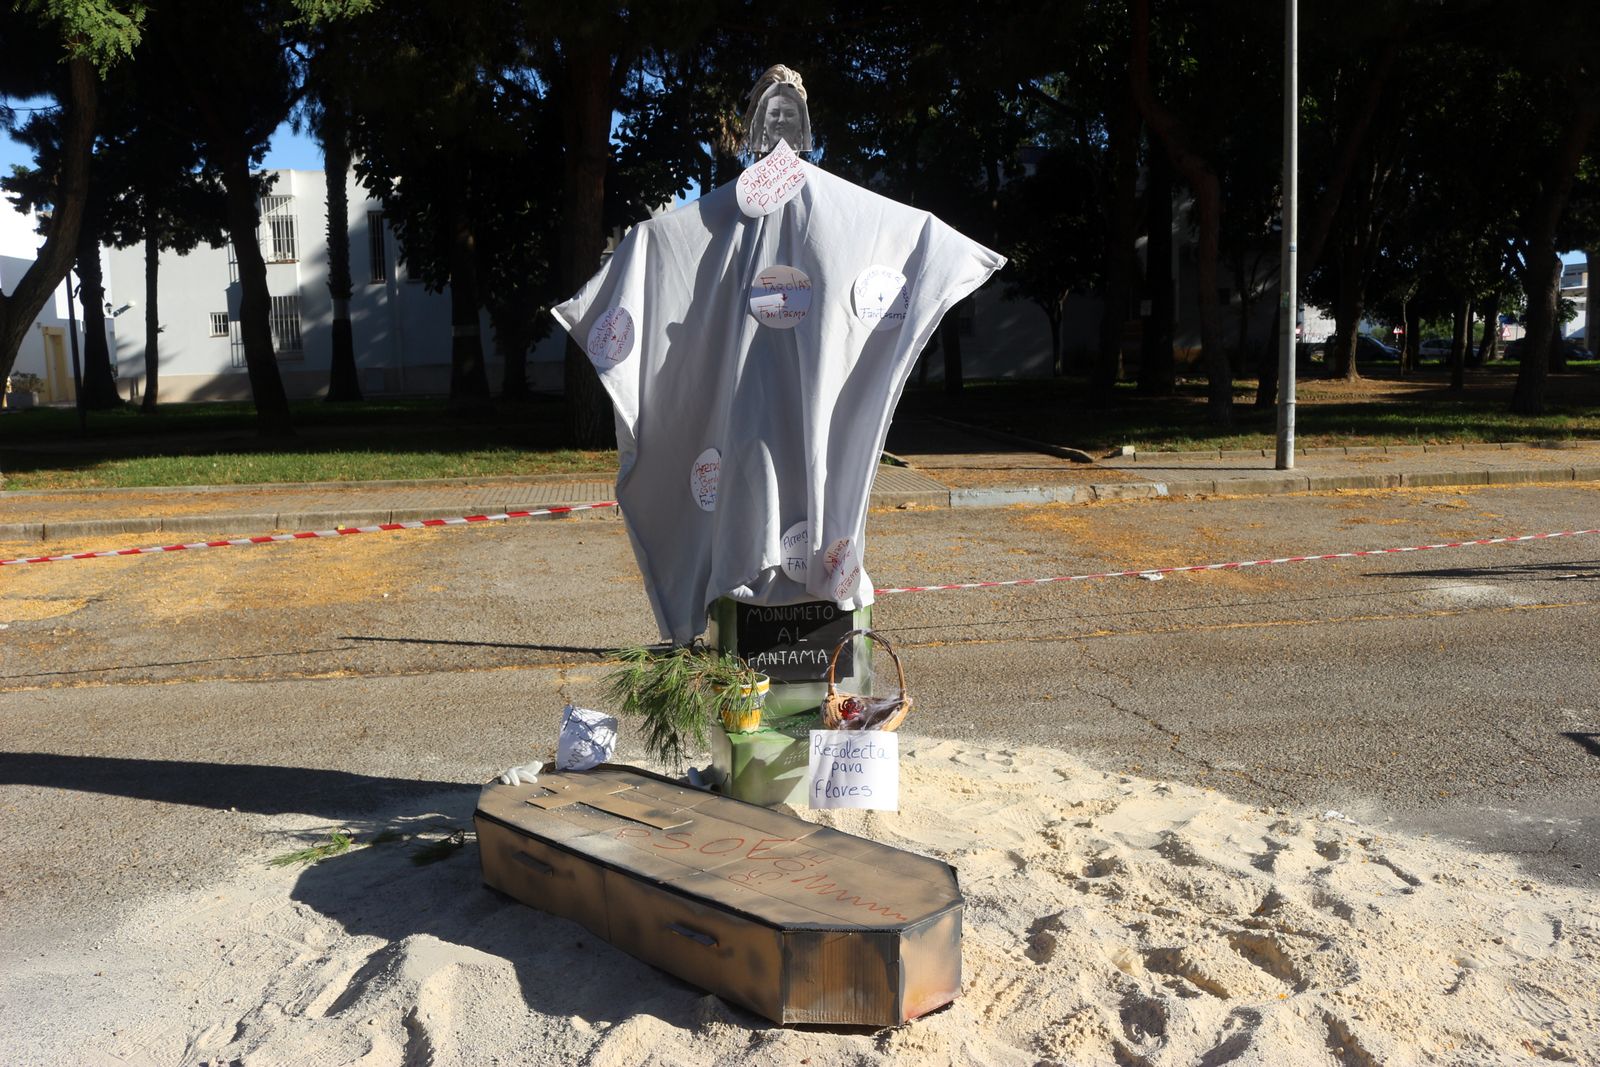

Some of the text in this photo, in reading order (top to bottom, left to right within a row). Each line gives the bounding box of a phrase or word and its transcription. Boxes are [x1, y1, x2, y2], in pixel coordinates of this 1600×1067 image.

[746, 605, 834, 624] MONUMETO
[777, 627, 808, 642] AL
[747, 649, 829, 666] FANTAMA
